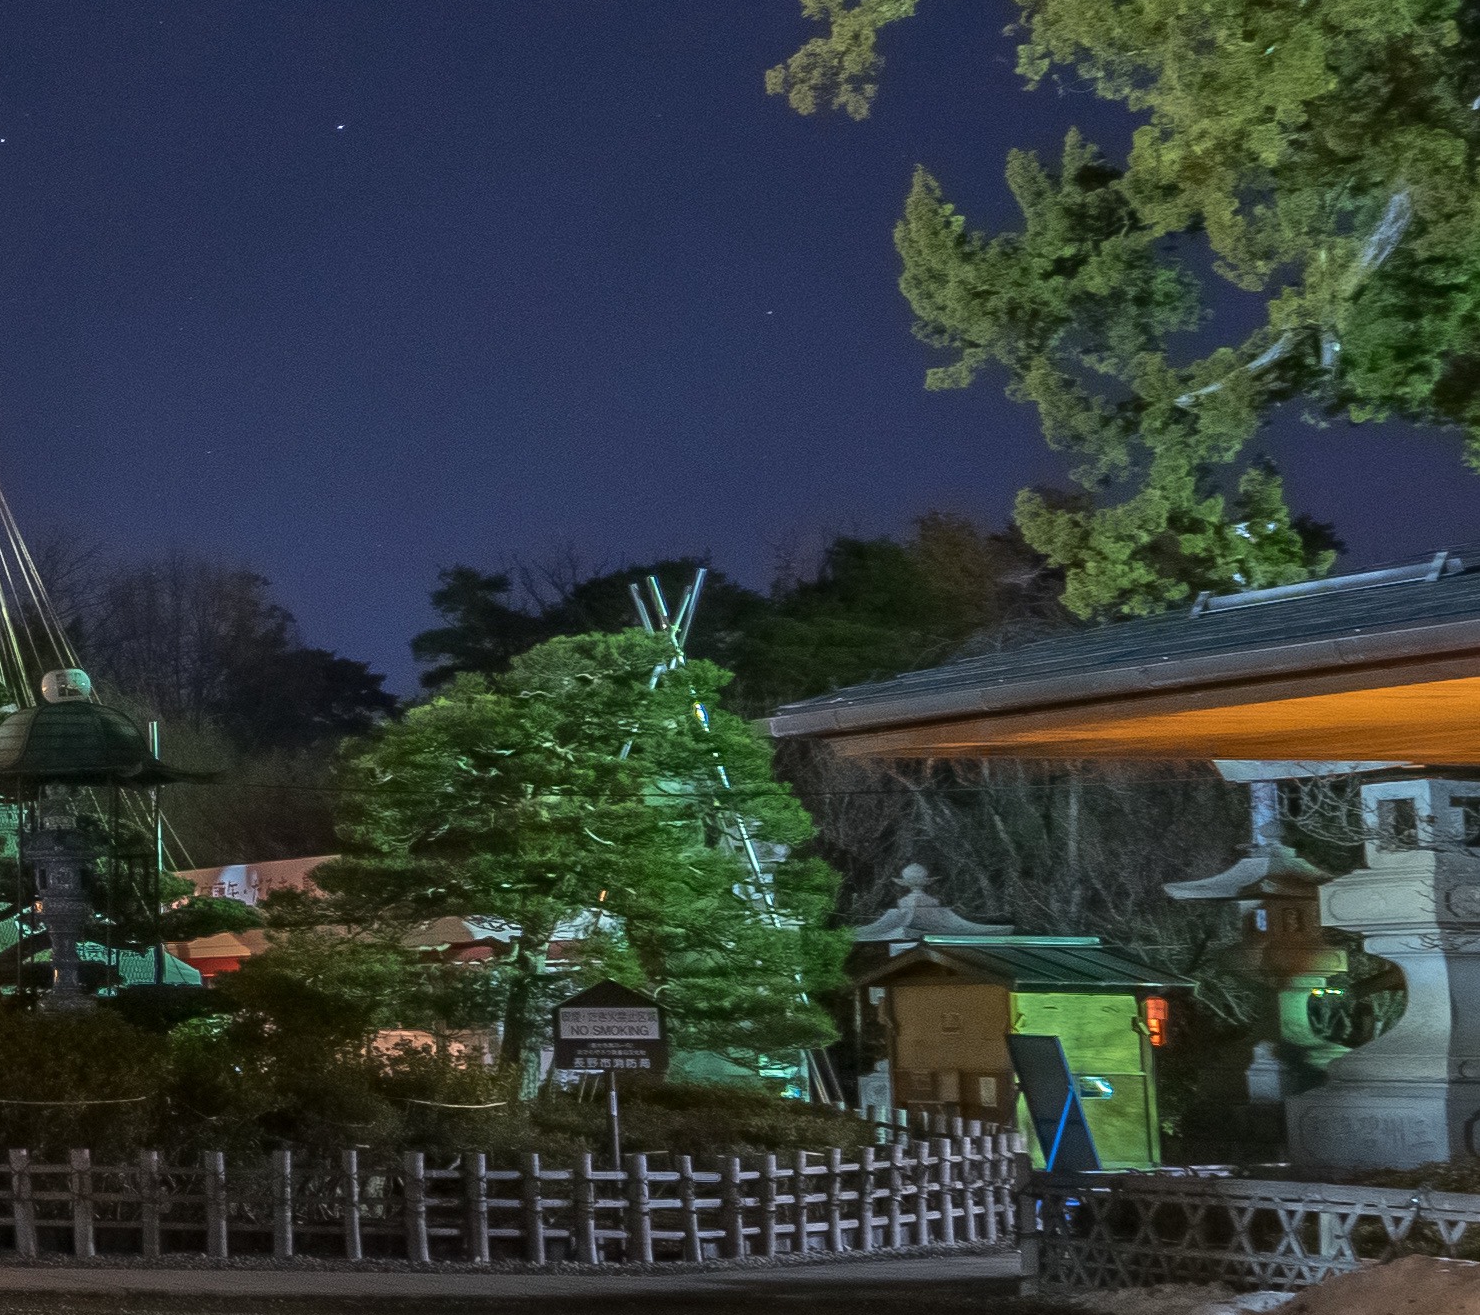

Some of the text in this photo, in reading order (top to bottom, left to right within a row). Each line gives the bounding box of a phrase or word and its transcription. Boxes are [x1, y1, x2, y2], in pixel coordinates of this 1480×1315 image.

[570, 1025, 650, 1037] NO SMOKING
[573, 1057, 651, 1069] 長野市消防局
